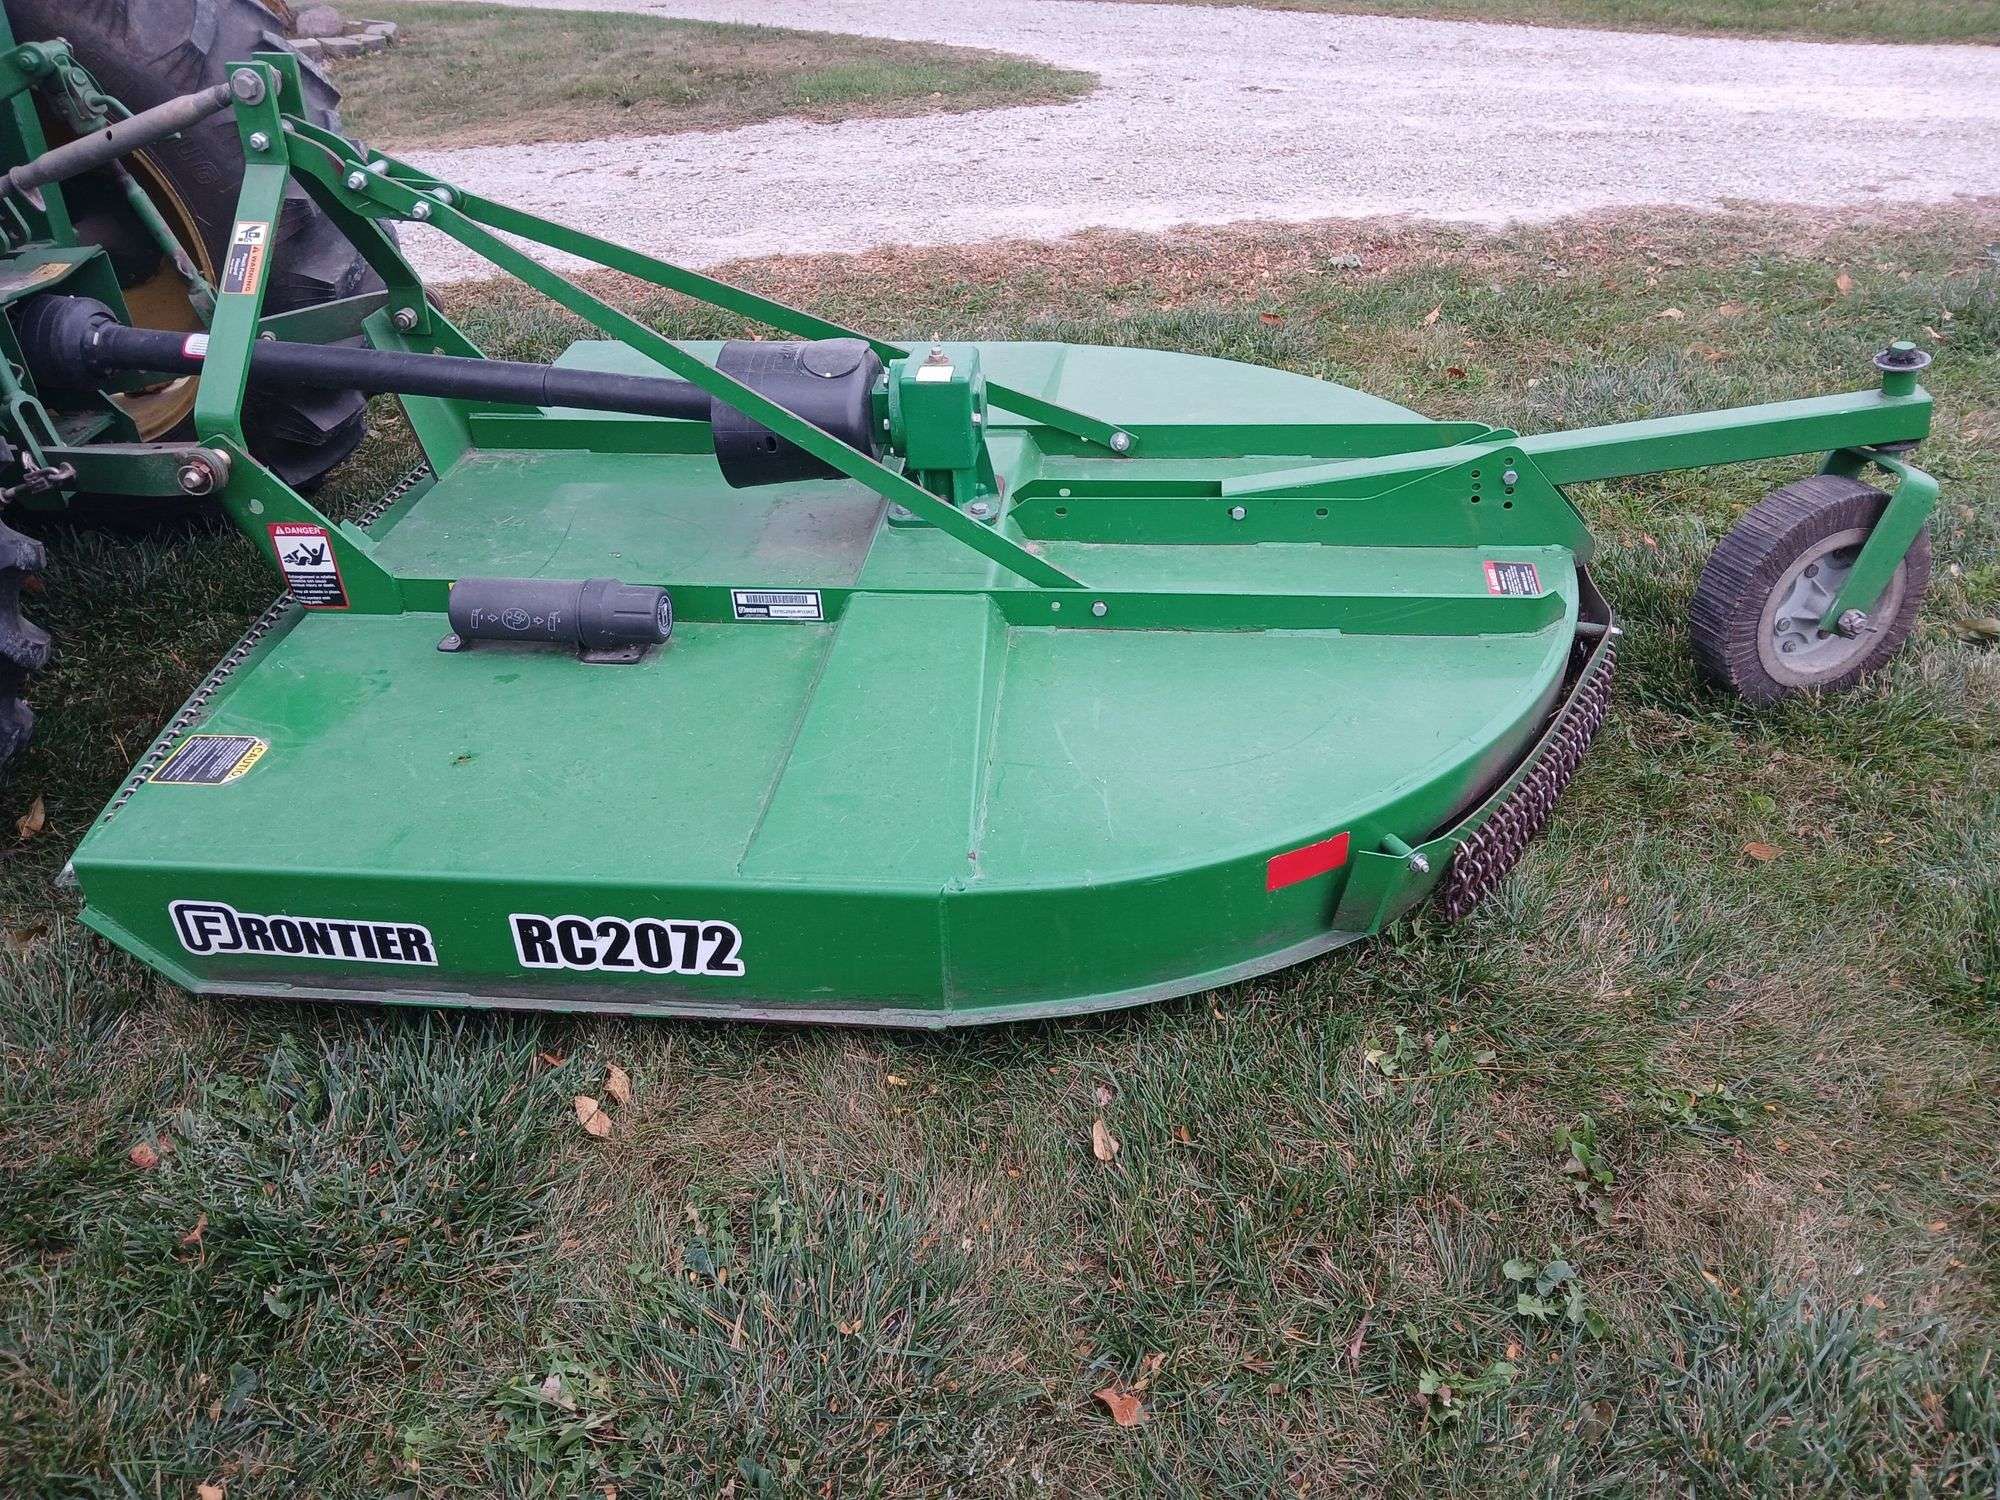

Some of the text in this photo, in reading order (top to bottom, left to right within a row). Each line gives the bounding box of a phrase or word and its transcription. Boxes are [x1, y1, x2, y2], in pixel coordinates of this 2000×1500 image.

[284, 526, 321, 535] DANGER
[229, 747, 263, 779] CAUTIO
[174, 903, 739, 972] FRONTIER RC2072
